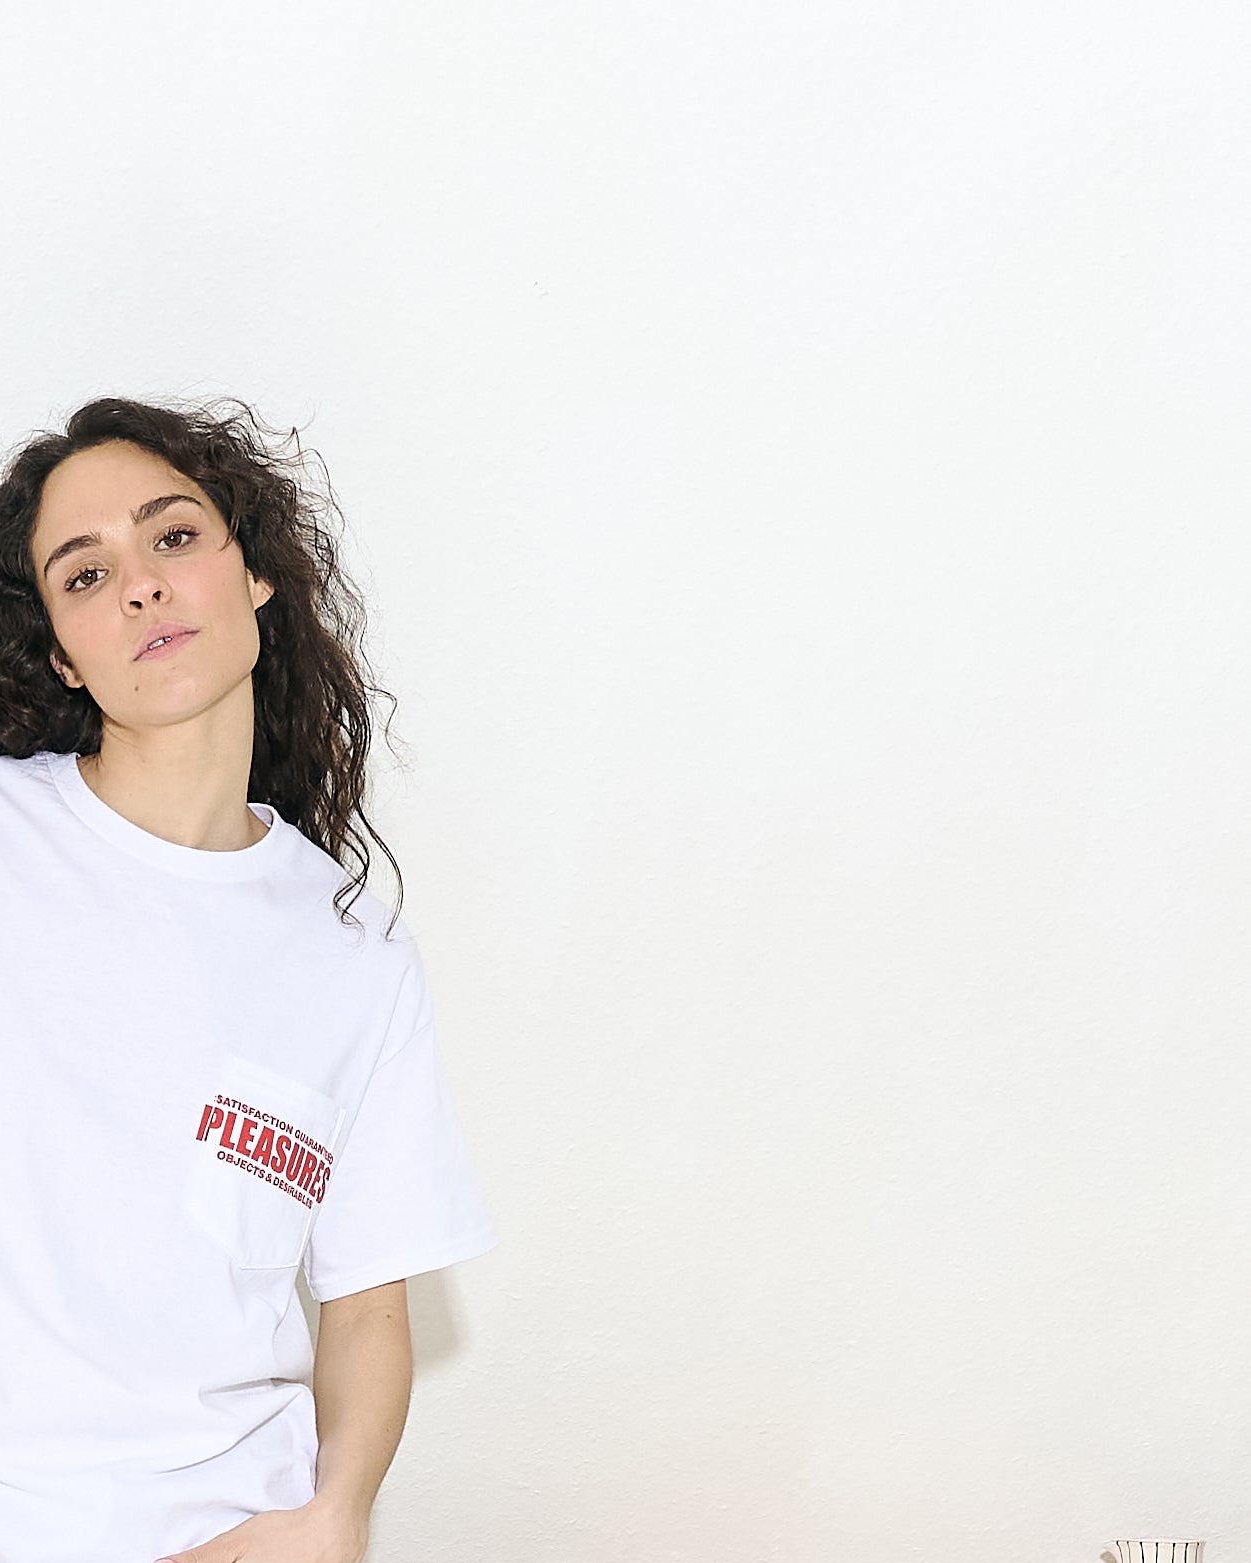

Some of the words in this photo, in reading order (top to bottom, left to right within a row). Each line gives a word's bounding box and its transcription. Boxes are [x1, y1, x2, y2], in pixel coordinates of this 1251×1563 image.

[215, 1094, 294, 1135] SATISFACTION
[196, 1104, 331, 1204] PLEASURES
[216, 1150, 266, 1179] OBJECTS
[265, 1173, 273, 1183] &
